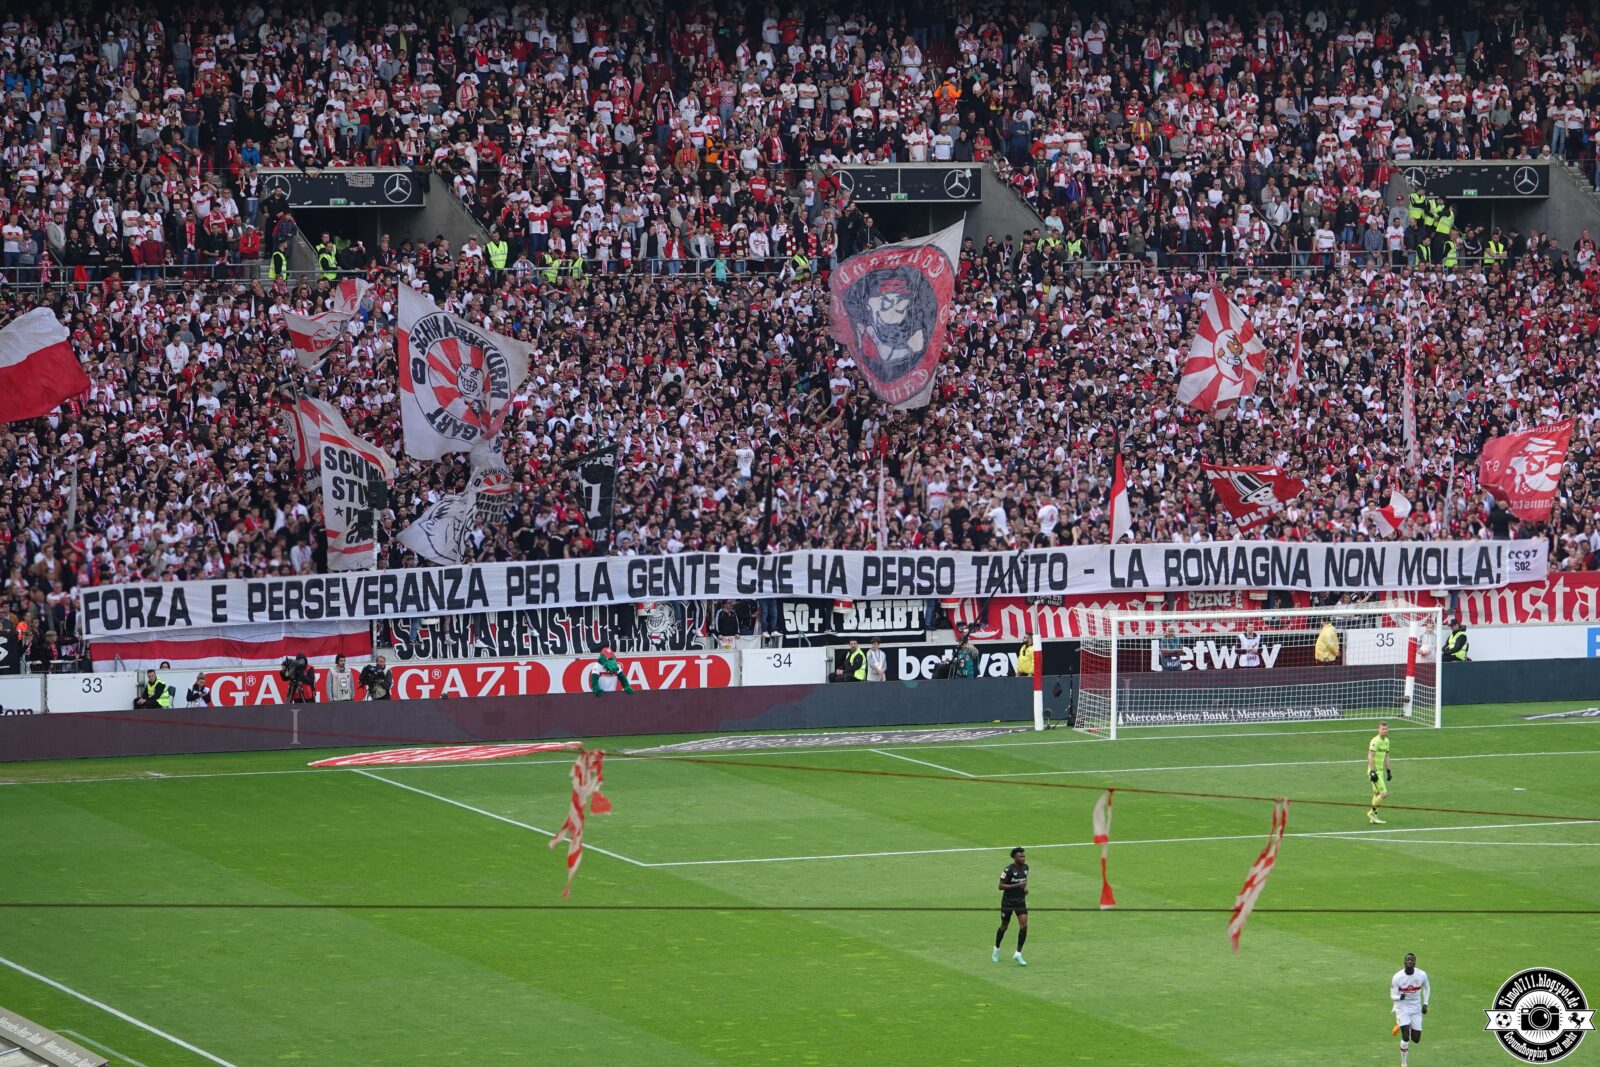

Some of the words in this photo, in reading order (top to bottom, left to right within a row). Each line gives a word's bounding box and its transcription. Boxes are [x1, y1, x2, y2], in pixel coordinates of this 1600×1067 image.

[1507, 548, 1539, 560] CC97
[83, 586, 192, 635] FORZA
[211, 584, 228, 623] E
[248, 567, 490, 622] PERSEVERANZA
[506, 563, 560, 607] PER
[575, 561, 615, 602] LA
[627, 554, 720, 598] GENTE
[736, 555, 794, 594] CHE
[807, 554, 848, 595] HA
[861, 555, 956, 596] PERSO
[971, 552, 1068, 594] TANTO
[1109, 548, 1149, 588] LA
[1164, 546, 1312, 588] ROMAGNA
[1324, 546, 1386, 587] NON
[1398, 545, 1503, 586] MOLLA!
[1188, 591, 1232, 609] SZENE
[843, 600, 924, 631] BLEIBT
[1376, 632, 1395, 648] 35
[81, 677, 103, 693] 33
[1126, 712, 1199, 722] Mercedes-Benz
[1203, 711, 1229, 720] Bank
[1237, 708, 1312, 719] Mercedes-Benz
[1313, 707, 1340, 717] Bank
